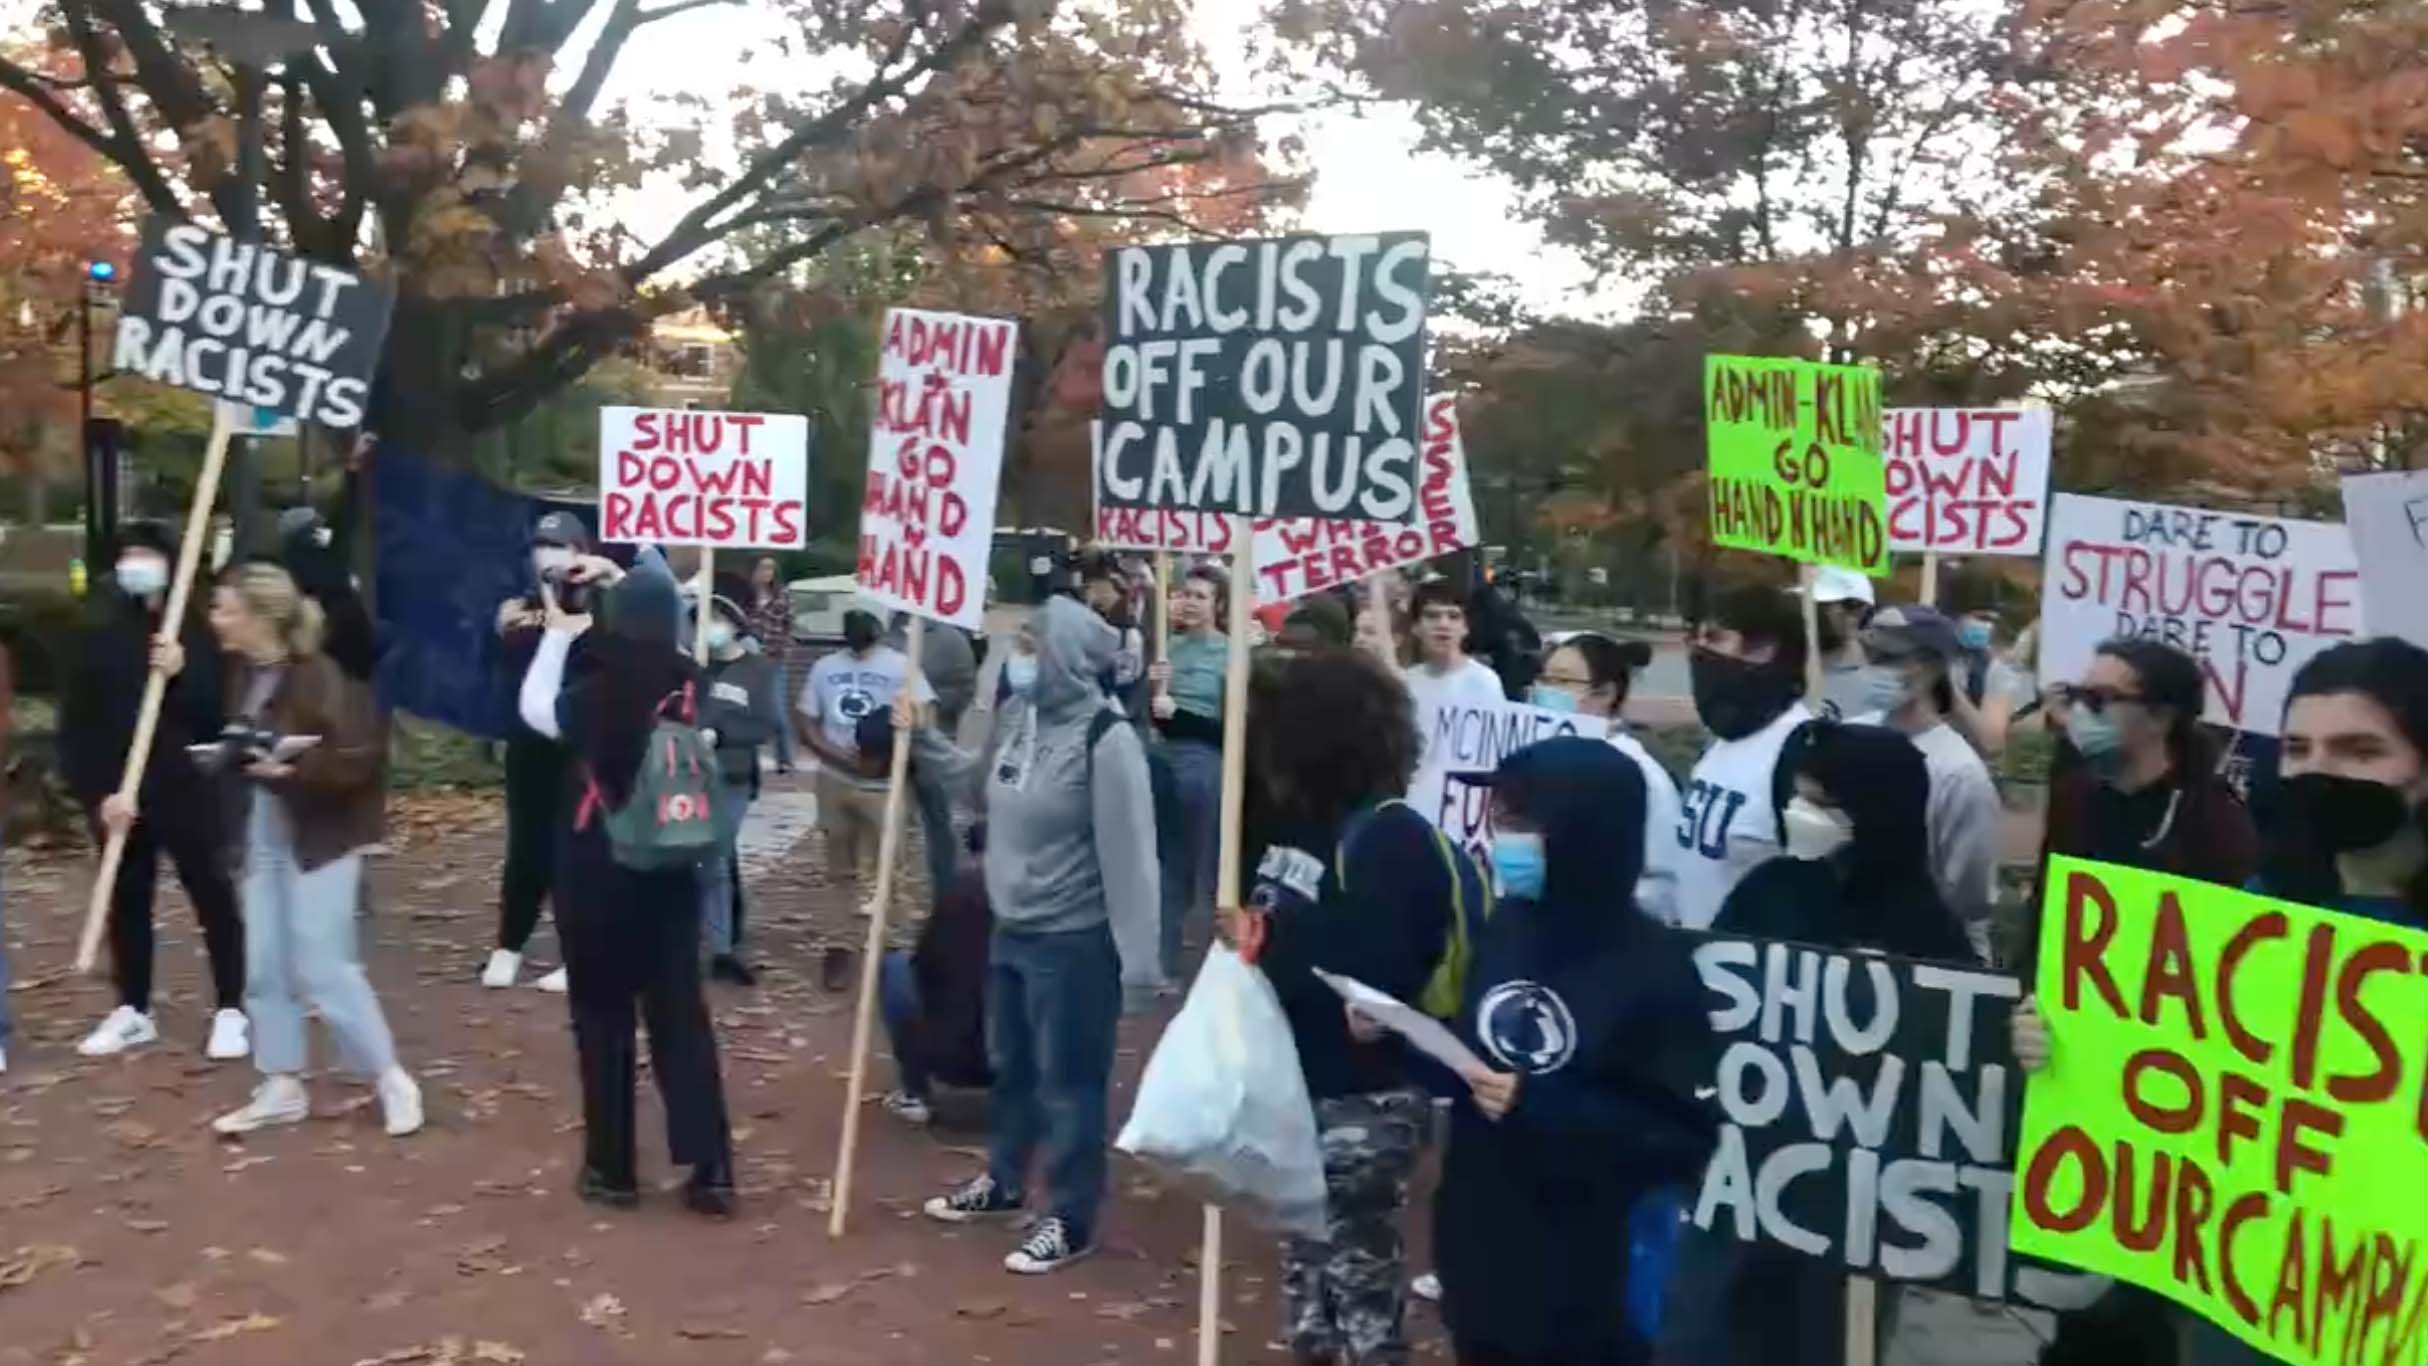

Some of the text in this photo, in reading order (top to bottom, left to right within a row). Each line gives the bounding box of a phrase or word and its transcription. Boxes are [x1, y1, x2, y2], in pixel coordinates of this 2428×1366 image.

[152, 225, 358, 319] SHUT
[1117, 237, 1429, 344] RACISTS
[158, 278, 350, 363] DOWN
[883, 312, 1010, 376] ADMIN
[113, 316, 368, 428] RACISTS
[1103, 337, 1222, 425] OFF
[1240, 337, 1404, 438] OUR
[633, 413, 765, 455] SHUT
[874, 380, 971, 446] KLAN
[617, 451, 772, 496] DOWN
[897, 436, 956, 488] GO
[1103, 418, 1417, 520] CAMPUS
[1774, 438, 1830, 488] GO
[1885, 450, 2020, 498] OWN
[603, 493, 801, 544] RACISTS
[862, 471, 967, 537] HAND
[1711, 476, 1783, 545] HAND
[1888, 497, 2036, 550] CISTS
[2122, 509, 2288, 559] DARE TO
[856, 534, 965, 615] HAND
[1258, 521, 1464, 597] TERROR
[2061, 540, 2358, 636] STRUGGLE
[2229, 624, 2287, 667] TO
[1694, 940, 2020, 1070] SHUT
[1695, 1042, 2006, 1163] OWN
[2123, 1048, 2345, 1194] OFF
[1680, 1124, 2113, 1311] ACIST
